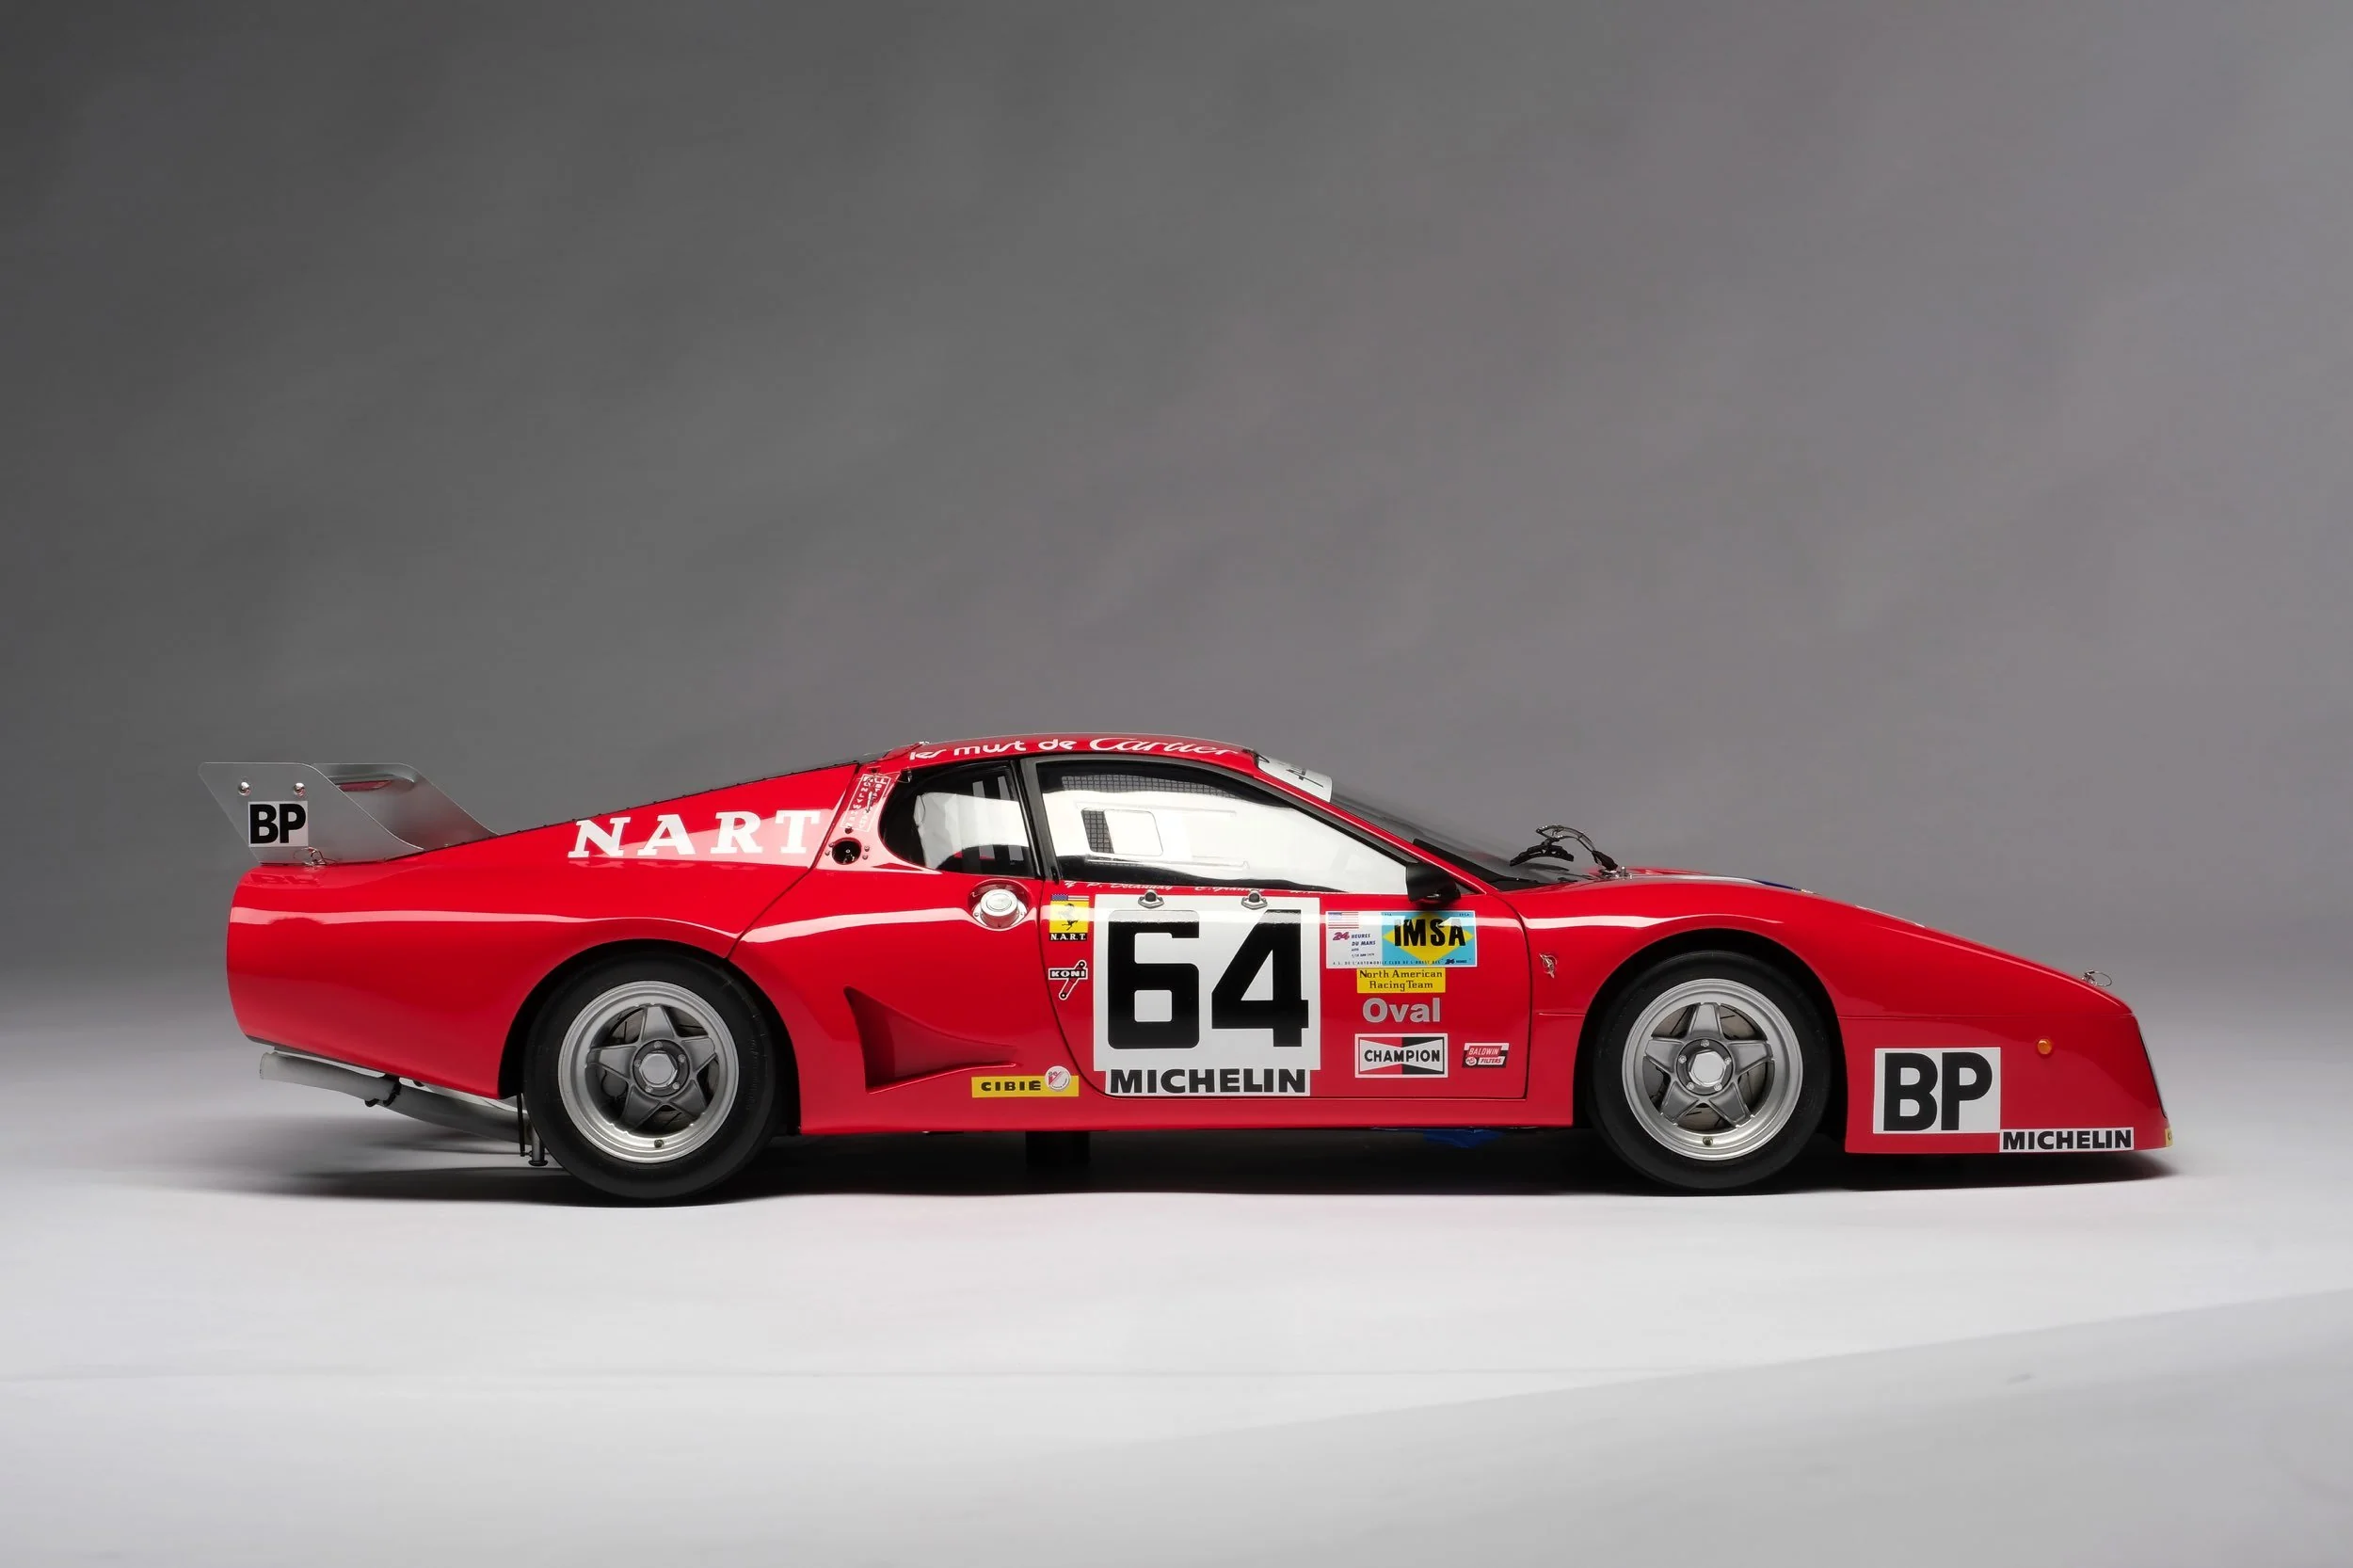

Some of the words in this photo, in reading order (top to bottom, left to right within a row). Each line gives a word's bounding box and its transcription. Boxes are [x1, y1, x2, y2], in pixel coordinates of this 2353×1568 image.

[953, 740, 1026, 756] must
[1038, 739, 1077, 750] de
[249, 803, 306, 844] BP
[568, 809, 821, 858] NART
[1333, 932, 1350, 941] 24
[1394, 919, 1465, 946] IMSA
[1108, 909, 1309, 1049] 64
[1359, 969, 1389, 979] North
[1392, 968, 1443, 979] American
[1369, 980, 1405, 992] Racing
[1406, 980, 1433, 989] Team
[1362, 998, 1441, 1023] Oval
[1364, 1049, 1440, 1063] CHAMPION
[1110, 1068, 1305, 1093] MICHELIN
[1882, 1051, 1993, 1131] BP
[2002, 1129, 2132, 1150] MICHELIN
